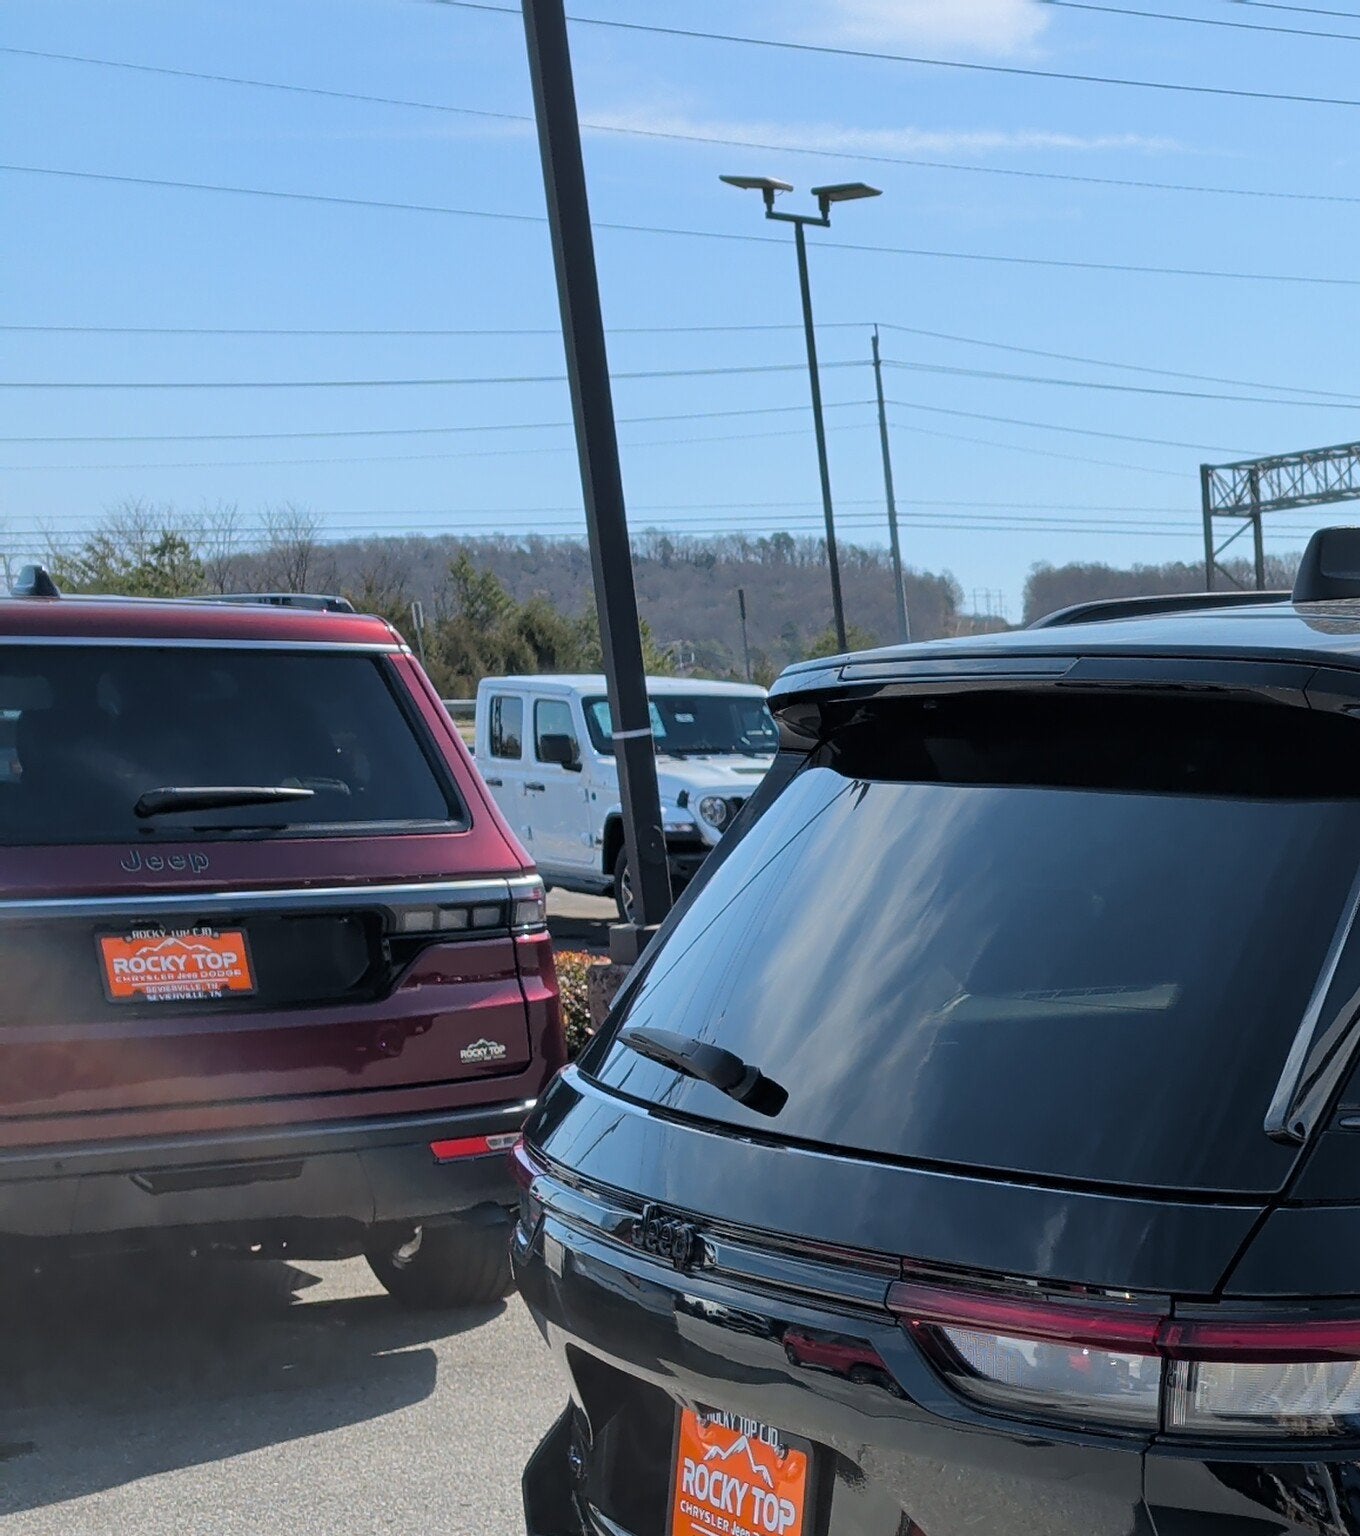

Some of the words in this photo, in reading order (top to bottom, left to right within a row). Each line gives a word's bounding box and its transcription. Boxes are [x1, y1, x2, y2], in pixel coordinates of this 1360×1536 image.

[120, 850, 209, 873] Jeep
[113, 954, 187, 974] ROCKY
[192, 952, 237, 971] TOP
[116, 973, 174, 983] CHRYSLER
[630, 1202, 696, 1272] Jeep
[740, 1416, 758, 1438] TOP
[760, 1424, 779, 1447] CJD
[682, 1457, 749, 1517] ROCKY
[751, 1488, 796, 1535] TOP
[680, 1500, 729, 1531] CHRYSLER
